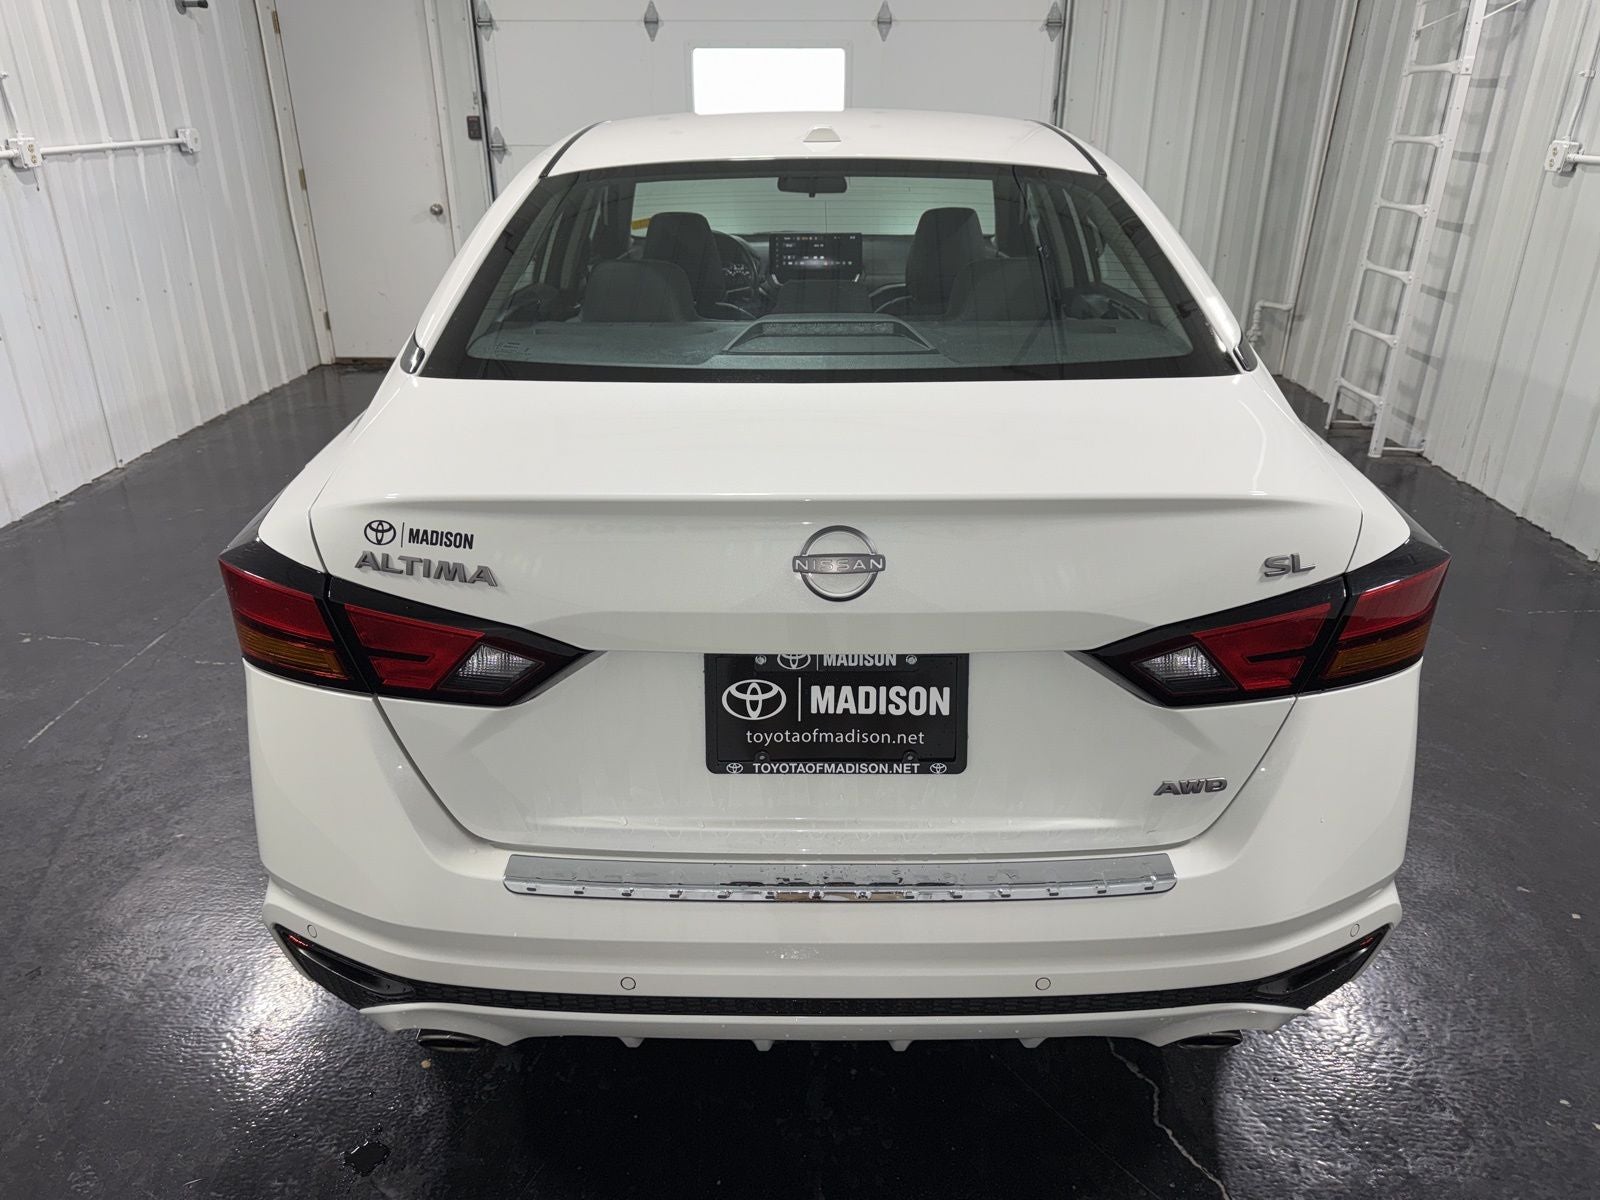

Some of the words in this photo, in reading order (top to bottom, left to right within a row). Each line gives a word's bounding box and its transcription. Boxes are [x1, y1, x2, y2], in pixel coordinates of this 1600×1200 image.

[408, 527, 475, 550] MADISON
[354, 550, 498, 587] ALTIMA
[795, 558, 883, 570] NISSAN
[1264, 552, 1316, 577] SL
[823, 653, 897, 667] MADISON
[810, 685, 950, 716] MADISON
[746, 728, 925, 746] toyotaofmadison.net
[752, 762, 920, 774] TOYOTAOFMADISON.NET
[1153, 777, 1228, 796] AWD
